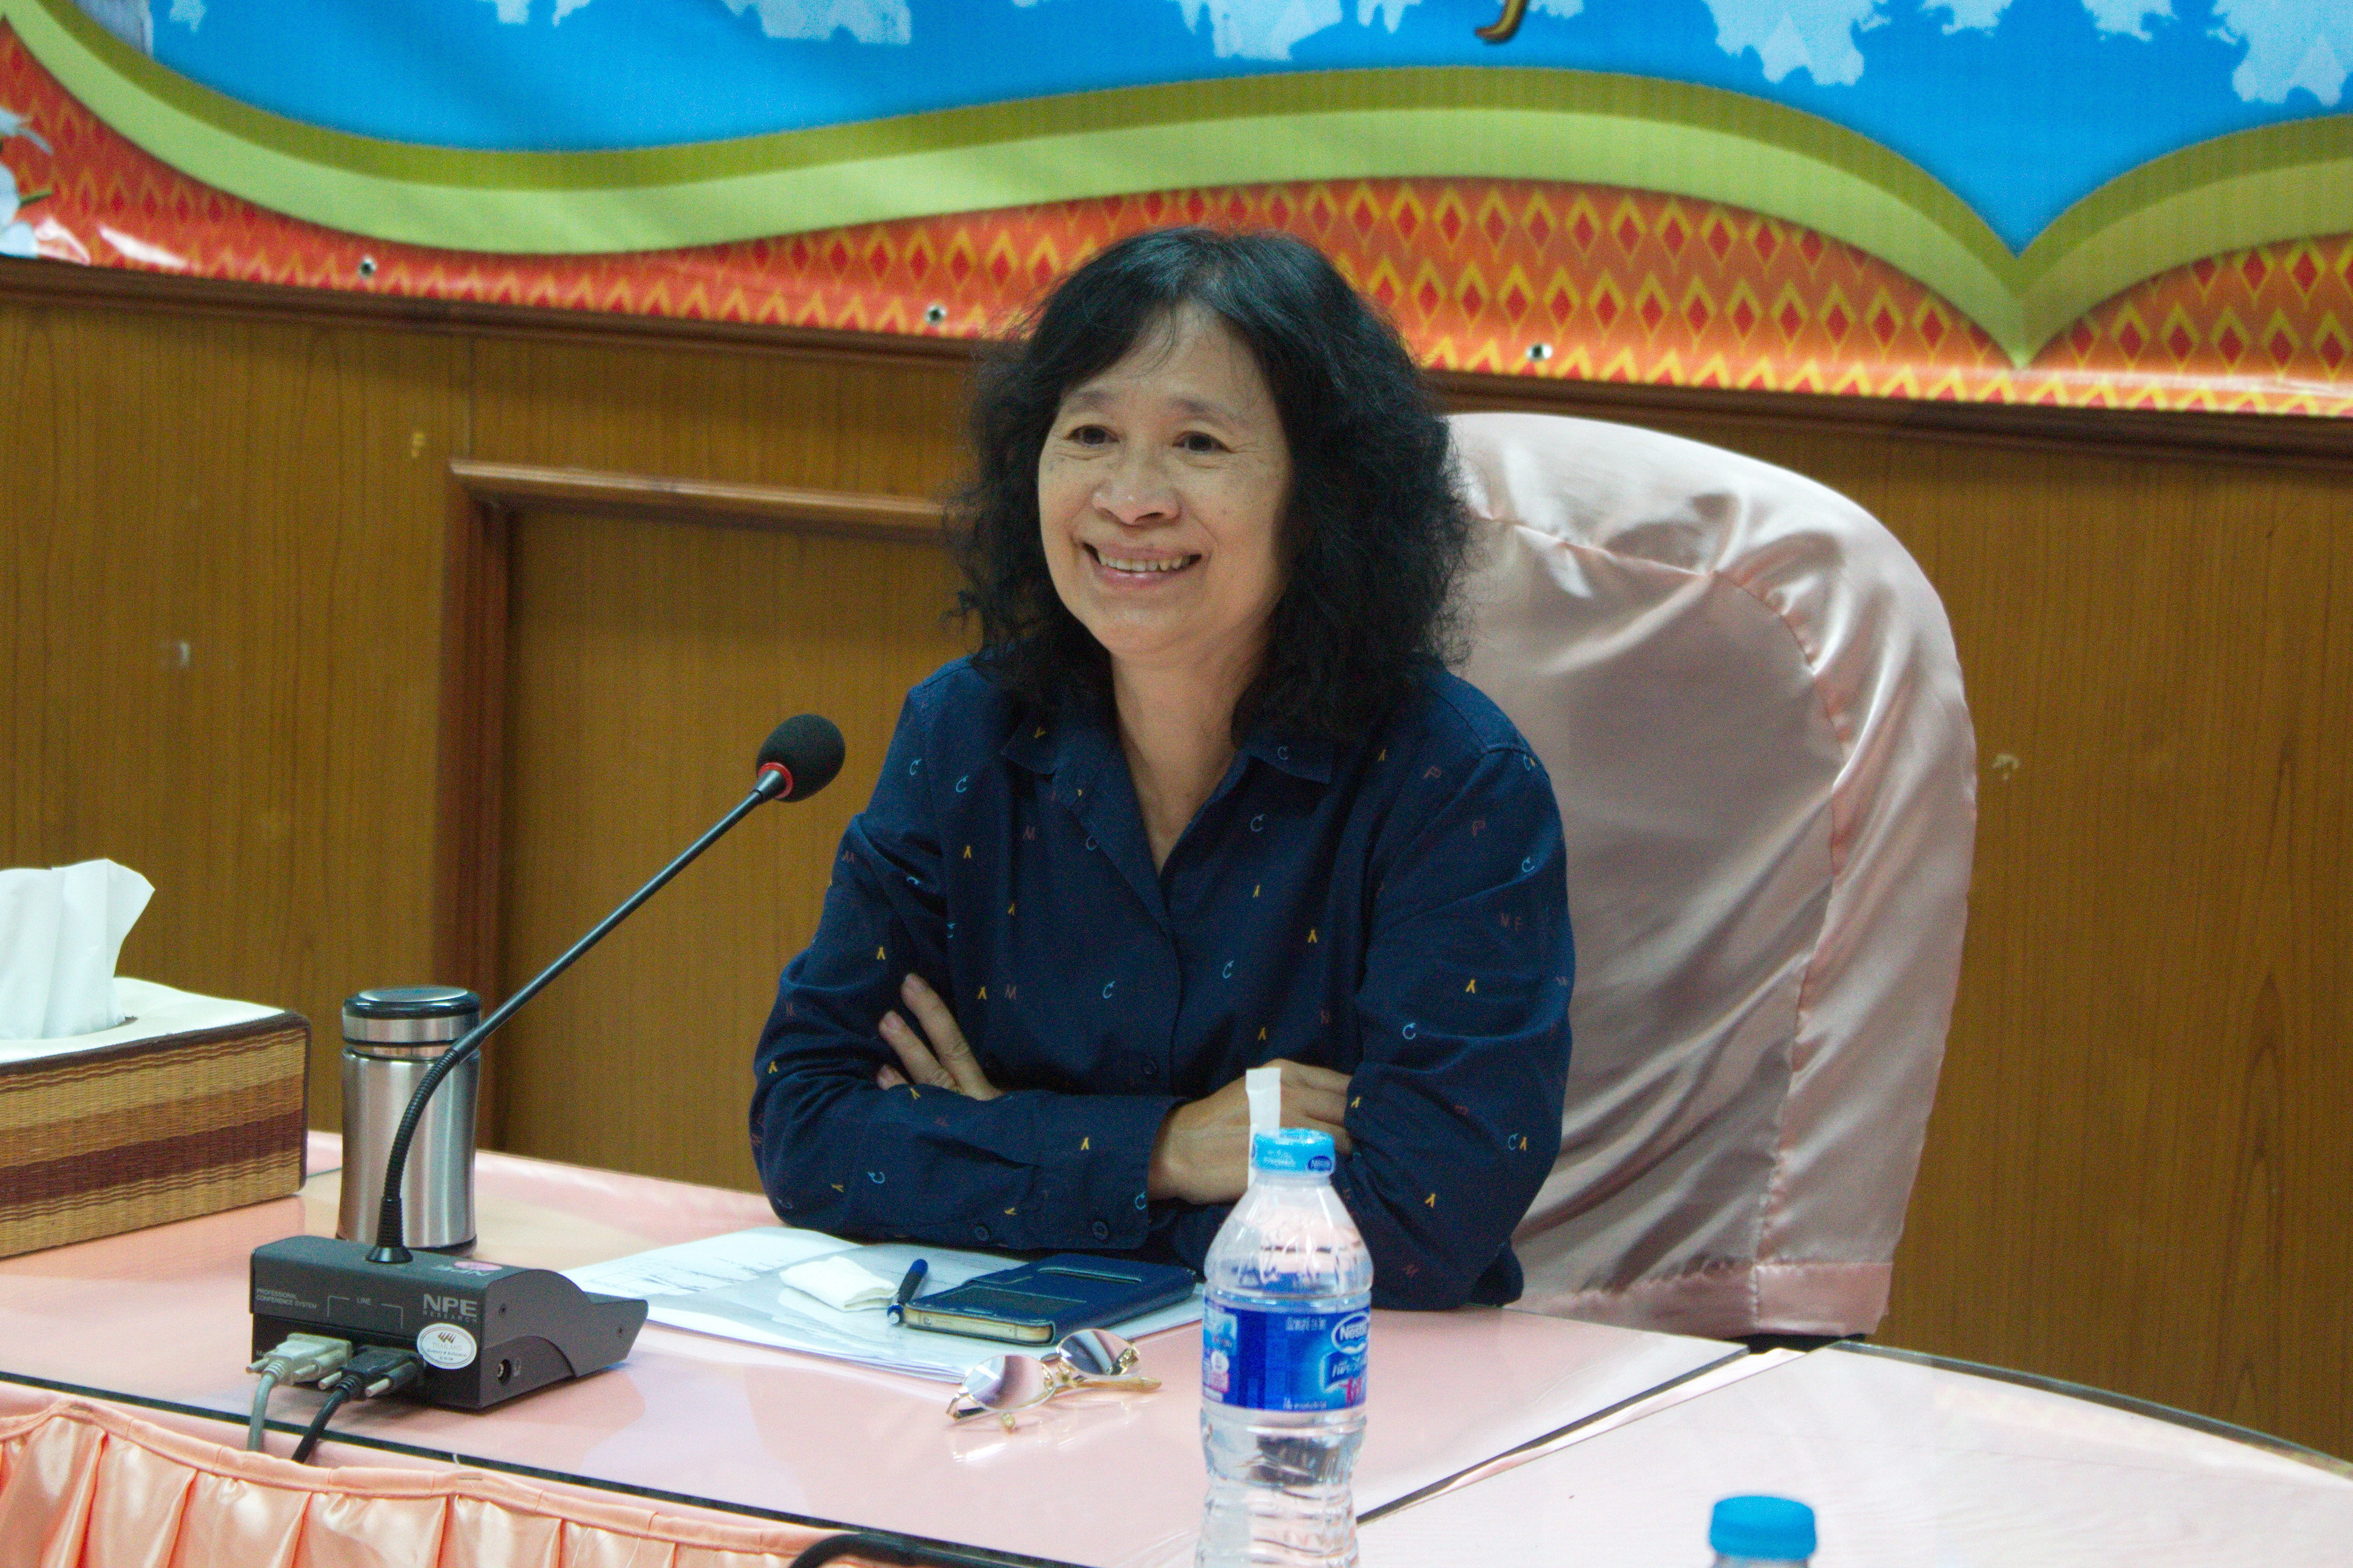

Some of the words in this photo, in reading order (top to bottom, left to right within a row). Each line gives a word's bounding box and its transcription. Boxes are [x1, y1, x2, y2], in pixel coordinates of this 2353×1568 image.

[256, 1288, 297, 1299] PROFESSIONAL
[255, 1294, 293, 1306] CONFERENCE
[294, 1300, 317, 1309] SYSTEM
[357, 1297, 371, 1306] LINE
[423, 1293, 478, 1318] NPE
[423, 1310, 477, 1323] RESEARCH
[433, 1342, 462, 1352] THAILAND
